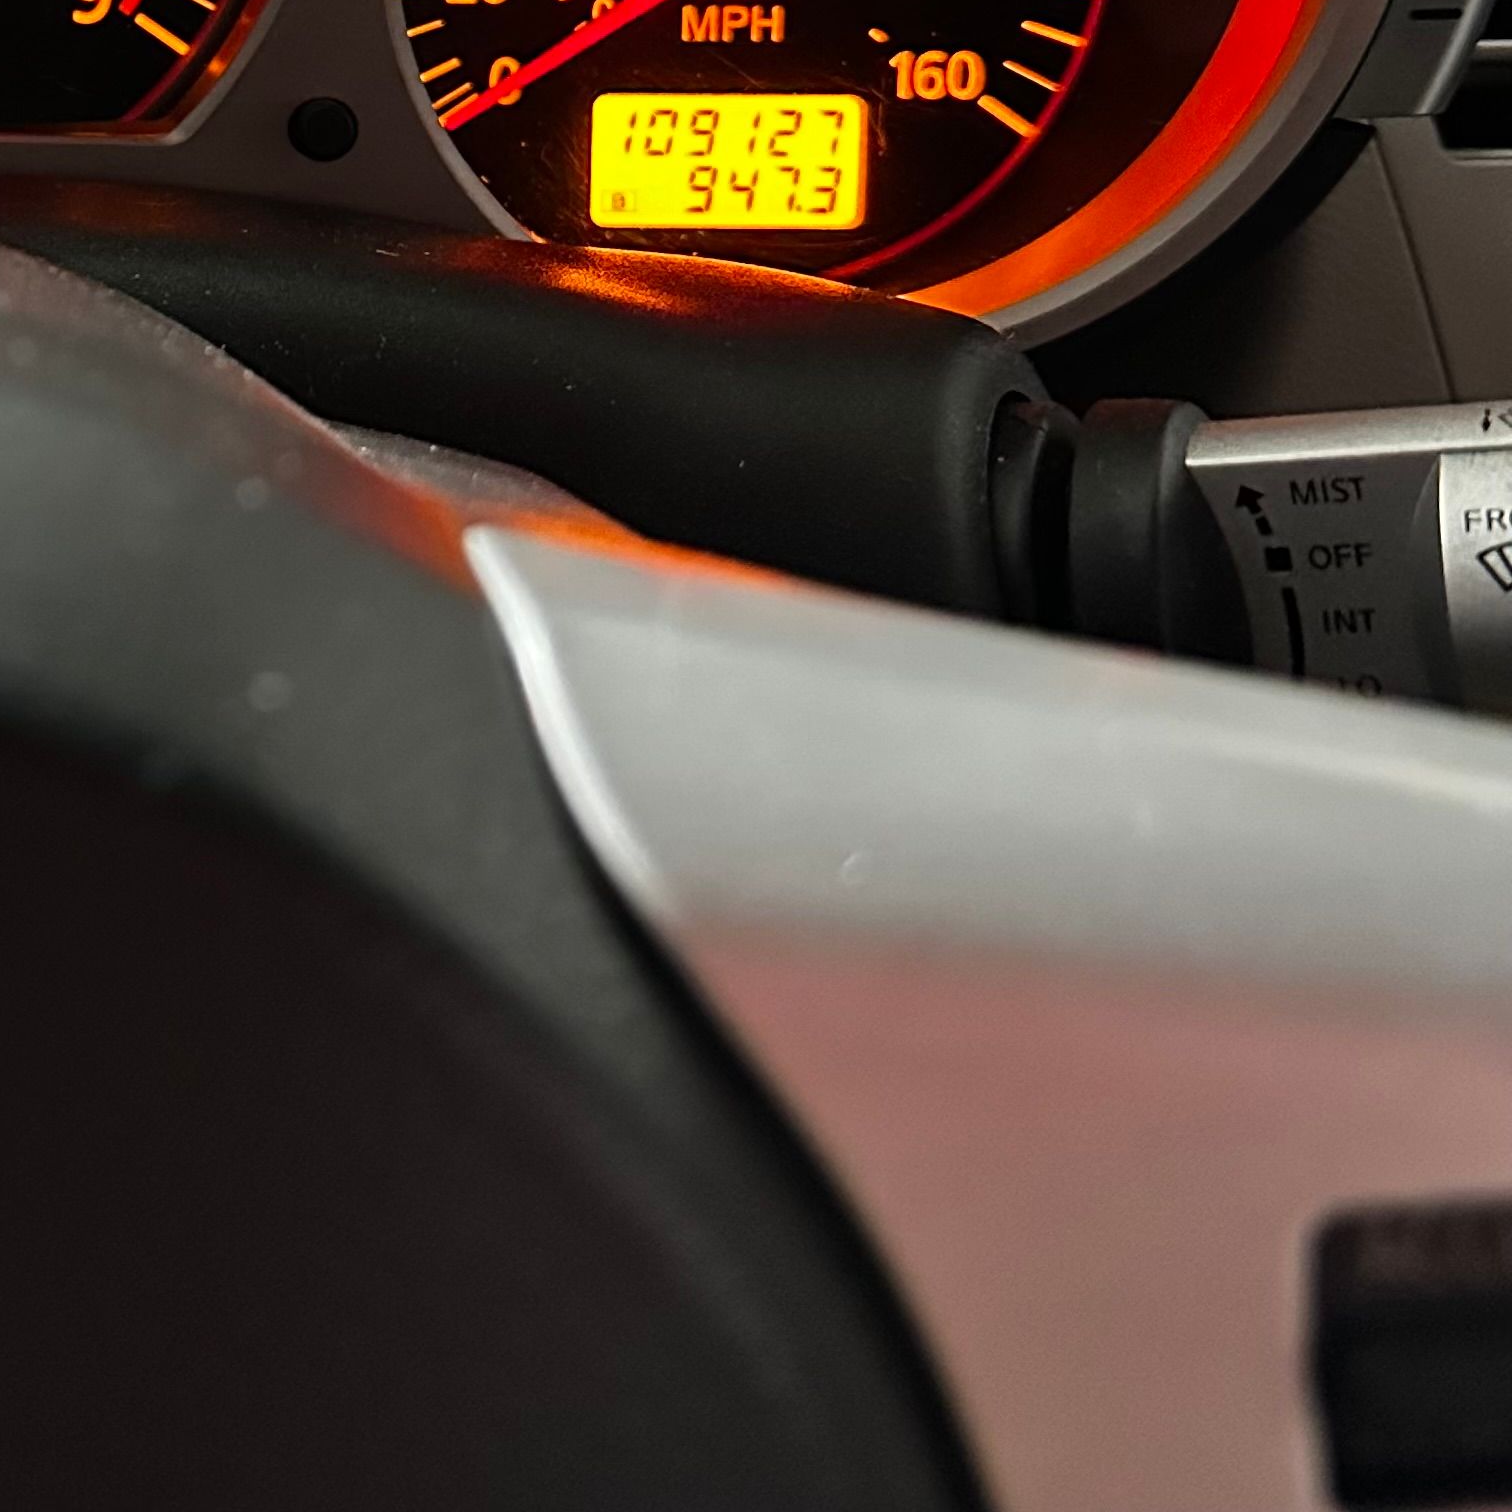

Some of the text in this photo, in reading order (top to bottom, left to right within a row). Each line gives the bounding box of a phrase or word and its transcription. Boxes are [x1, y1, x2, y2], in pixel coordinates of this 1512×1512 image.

[681, 5, 785, 42] MPH
[889, 50, 986, 100] 160
[625, 109, 844, 157] 109127
[686, 166, 841, 213] 947.3
[1289, 477, 1365, 505] MIST
[1308, 543, 1372, 570] OFF
[1322, 608, 1375, 634] INT
